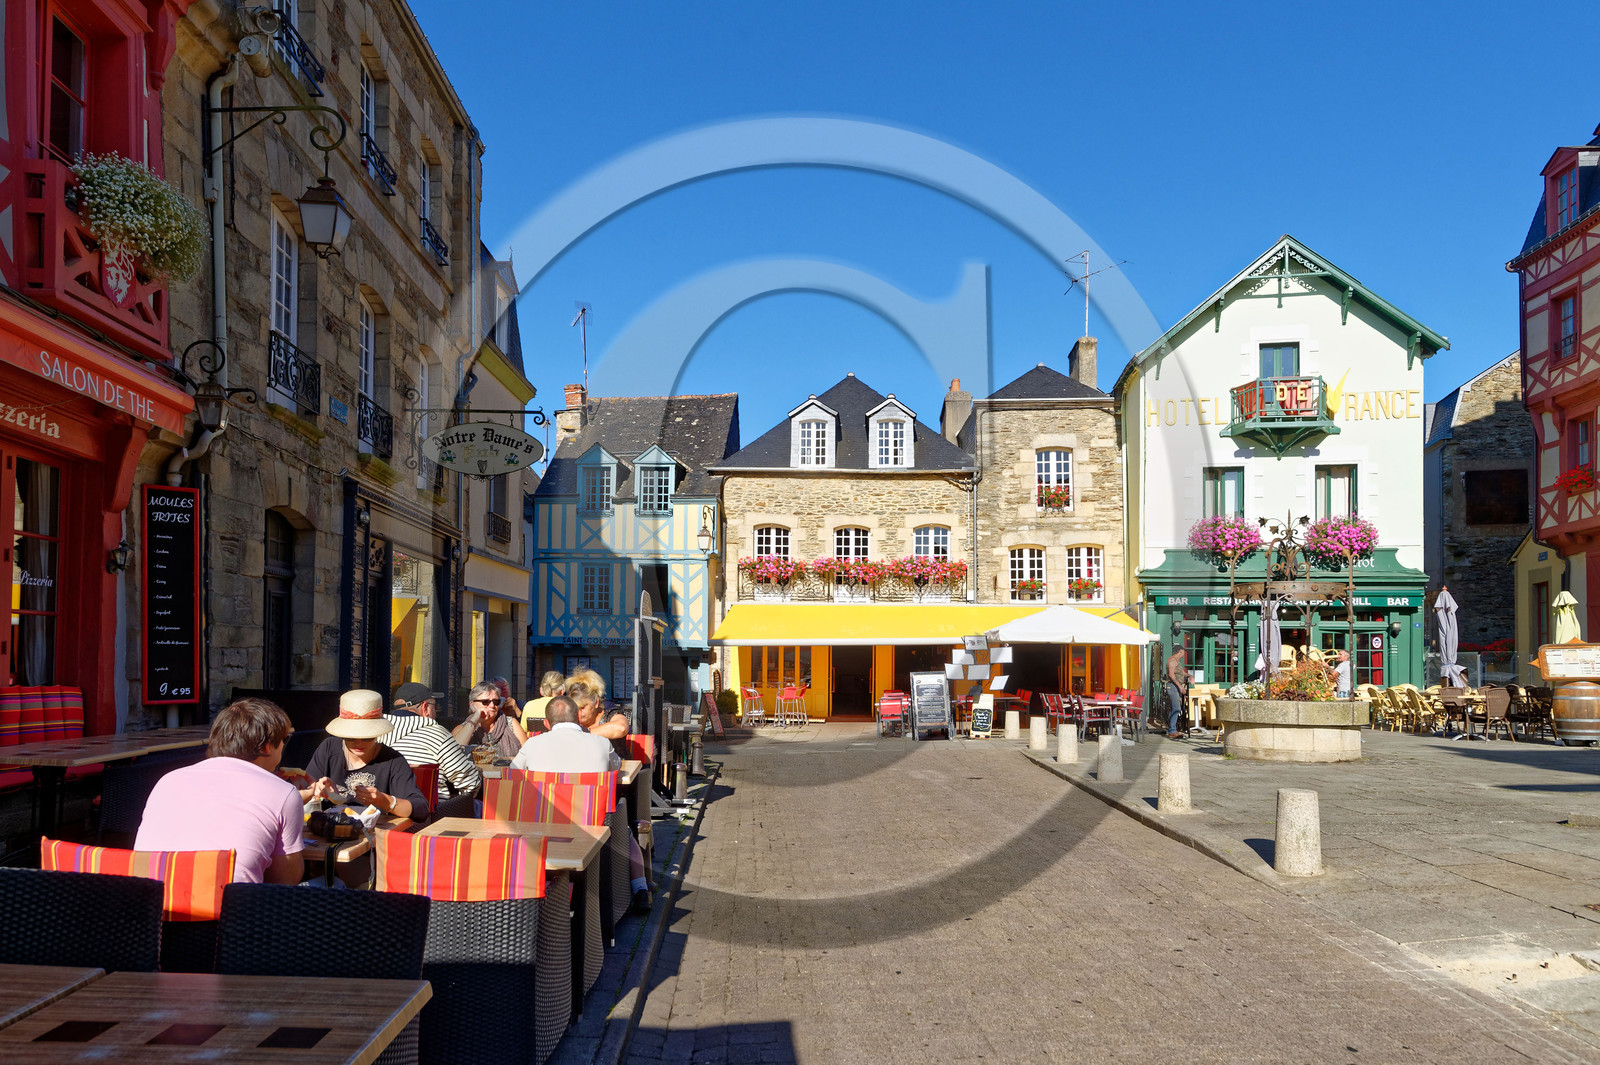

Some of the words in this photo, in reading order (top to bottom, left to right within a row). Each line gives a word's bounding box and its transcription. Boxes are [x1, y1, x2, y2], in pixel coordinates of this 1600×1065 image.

[40, 350, 99, 399] SALON
[104, 379, 125, 409] DE
[128, 390, 155, 422] THE
[1147, 396, 1228, 427] HOTEL
[1276, 384, 1309, 402] DE
[1341, 390, 1421, 422] RANCE
[432, 430, 476, 450] Notre
[483, 427, 534, 454] Dame's
[147, 495, 194, 508] MOULES
[152, 511, 190, 523] FRITES
[19, 570, 53, 587] Pizzeria
[1168, 597, 1188, 605] BAR
[1387, 597, 1409, 605] BAR
[562, 636, 632, 645] SAINT-COLOMBAN
